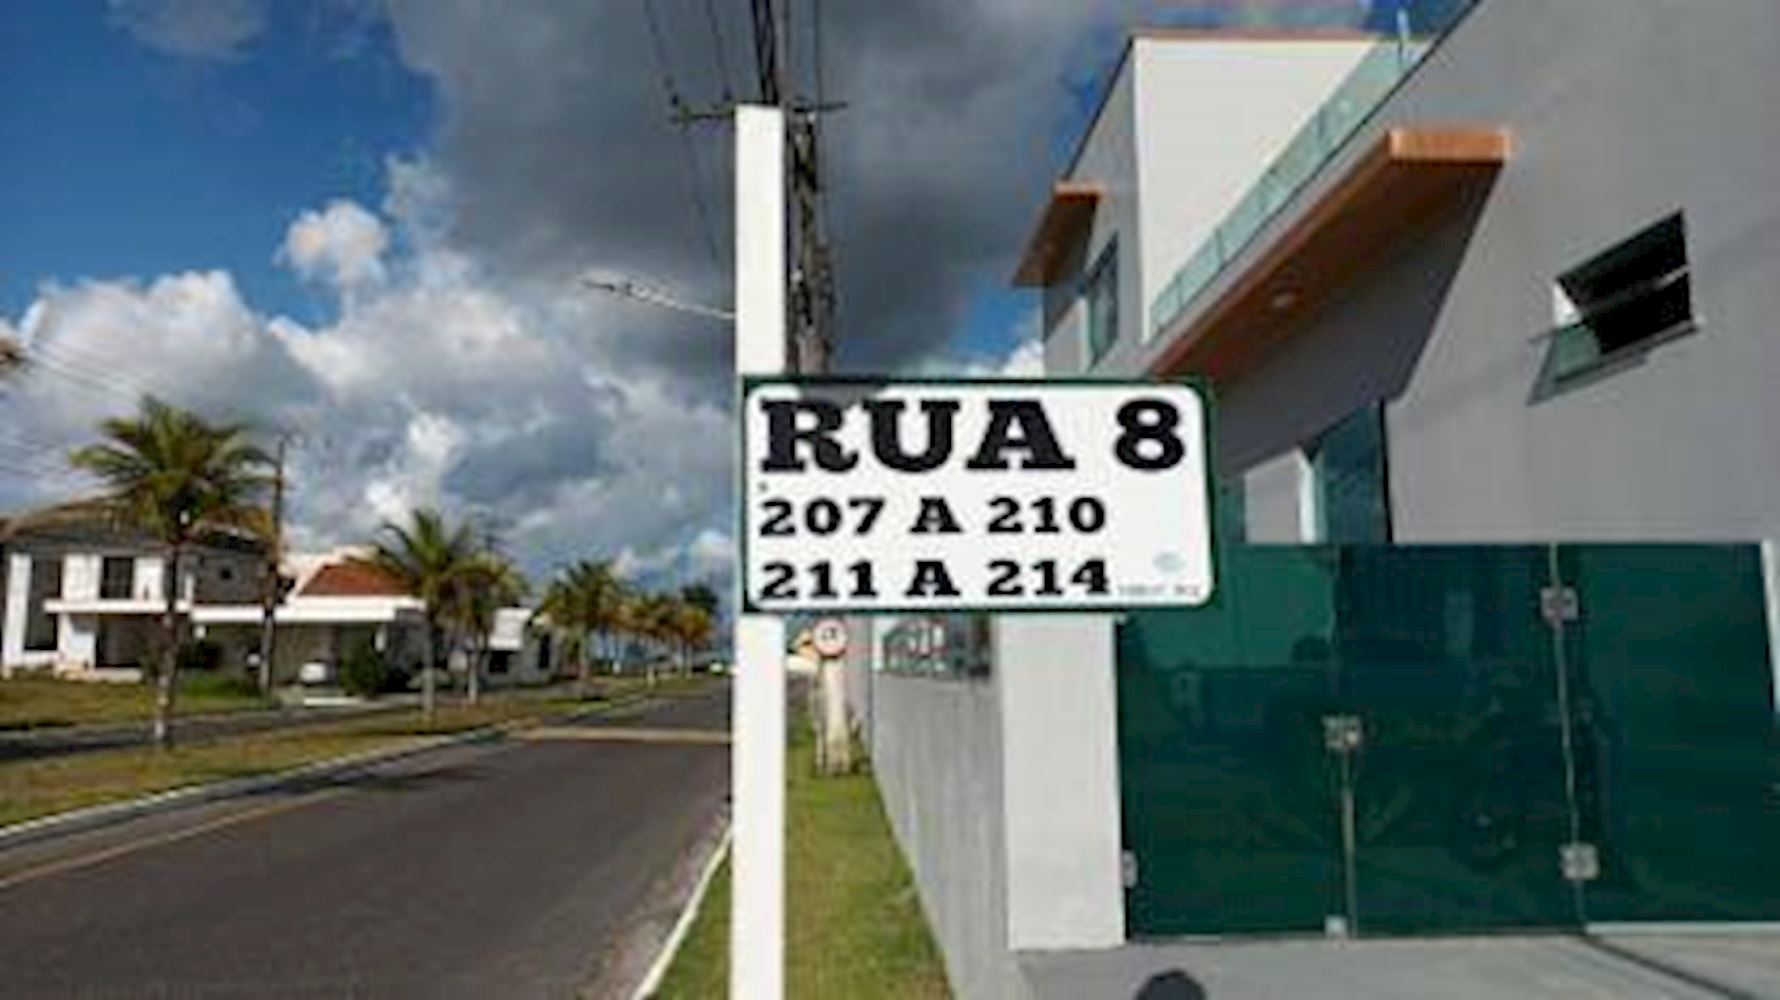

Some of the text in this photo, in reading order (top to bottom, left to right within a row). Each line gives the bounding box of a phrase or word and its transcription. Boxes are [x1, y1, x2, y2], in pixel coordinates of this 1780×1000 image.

[759, 398, 1186, 473] RUA 8
[759, 496, 1106, 536] 207 A 210
[759, 559, 1109, 600] 211 A 214
